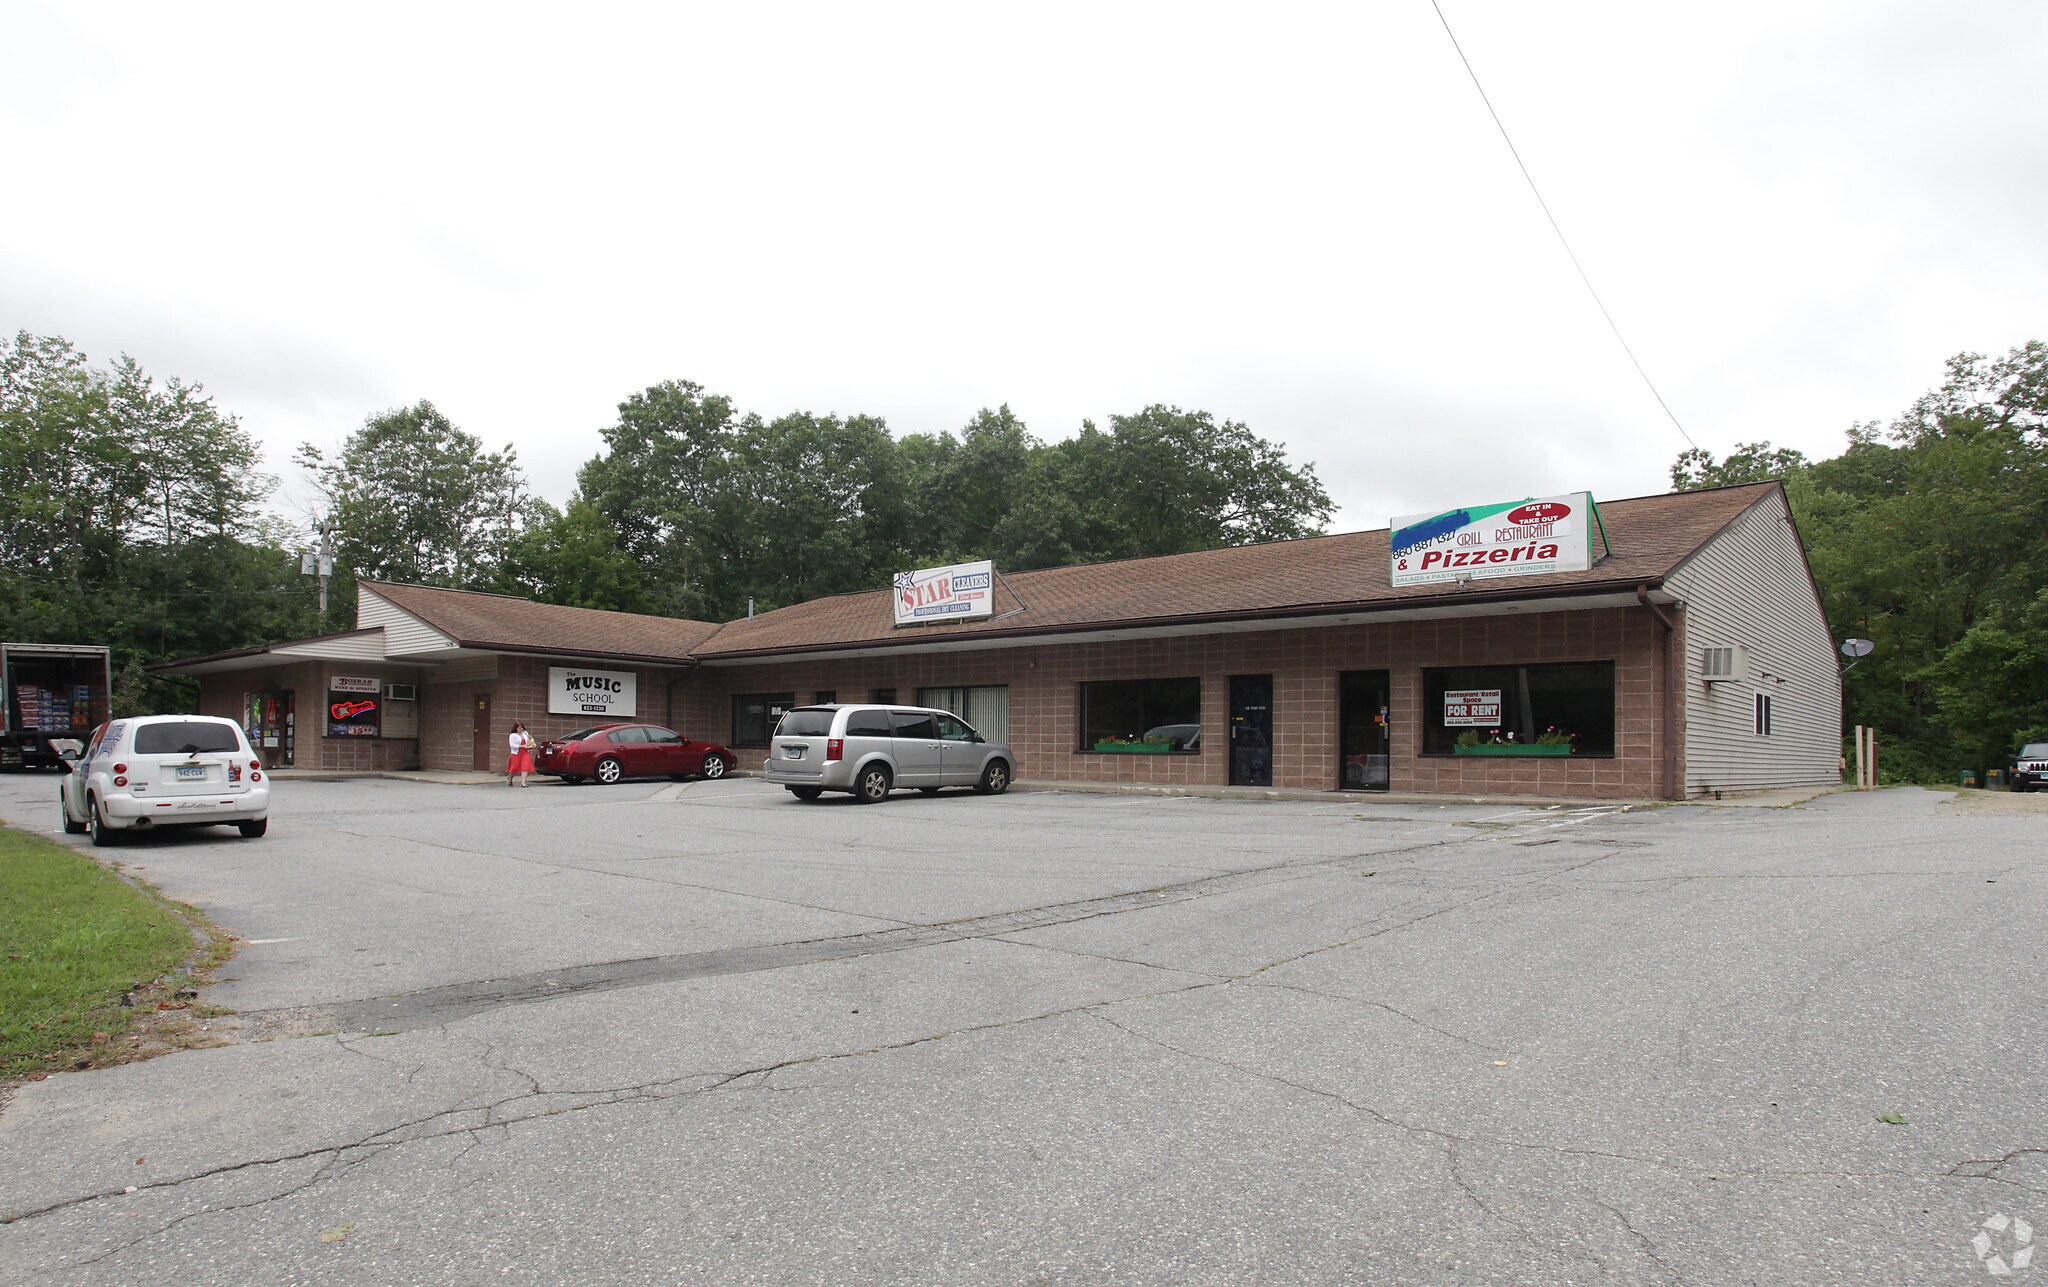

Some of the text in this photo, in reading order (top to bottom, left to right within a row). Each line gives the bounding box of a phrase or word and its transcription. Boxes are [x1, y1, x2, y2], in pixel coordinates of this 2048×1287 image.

[1525, 504, 1541, 512] EAT
[1519, 517, 1540, 525] TAKE
[1456, 531, 1483, 547] GRILL
[1495, 523, 1554, 543] RESTAURANT
[1392, 529, 1457, 560] 860 887 1327
[1397, 541, 1559, 571] & Pizzeria
[1395, 575, 1425, 583] SALADS
[1513, 563, 1556, 572] GRINDERS
[903, 577, 952, 612] STAR
[566, 676, 621, 693] MUSIC
[573, 693, 615, 704] SCHOOL
[1447, 704, 1498, 717] FOR RENT
